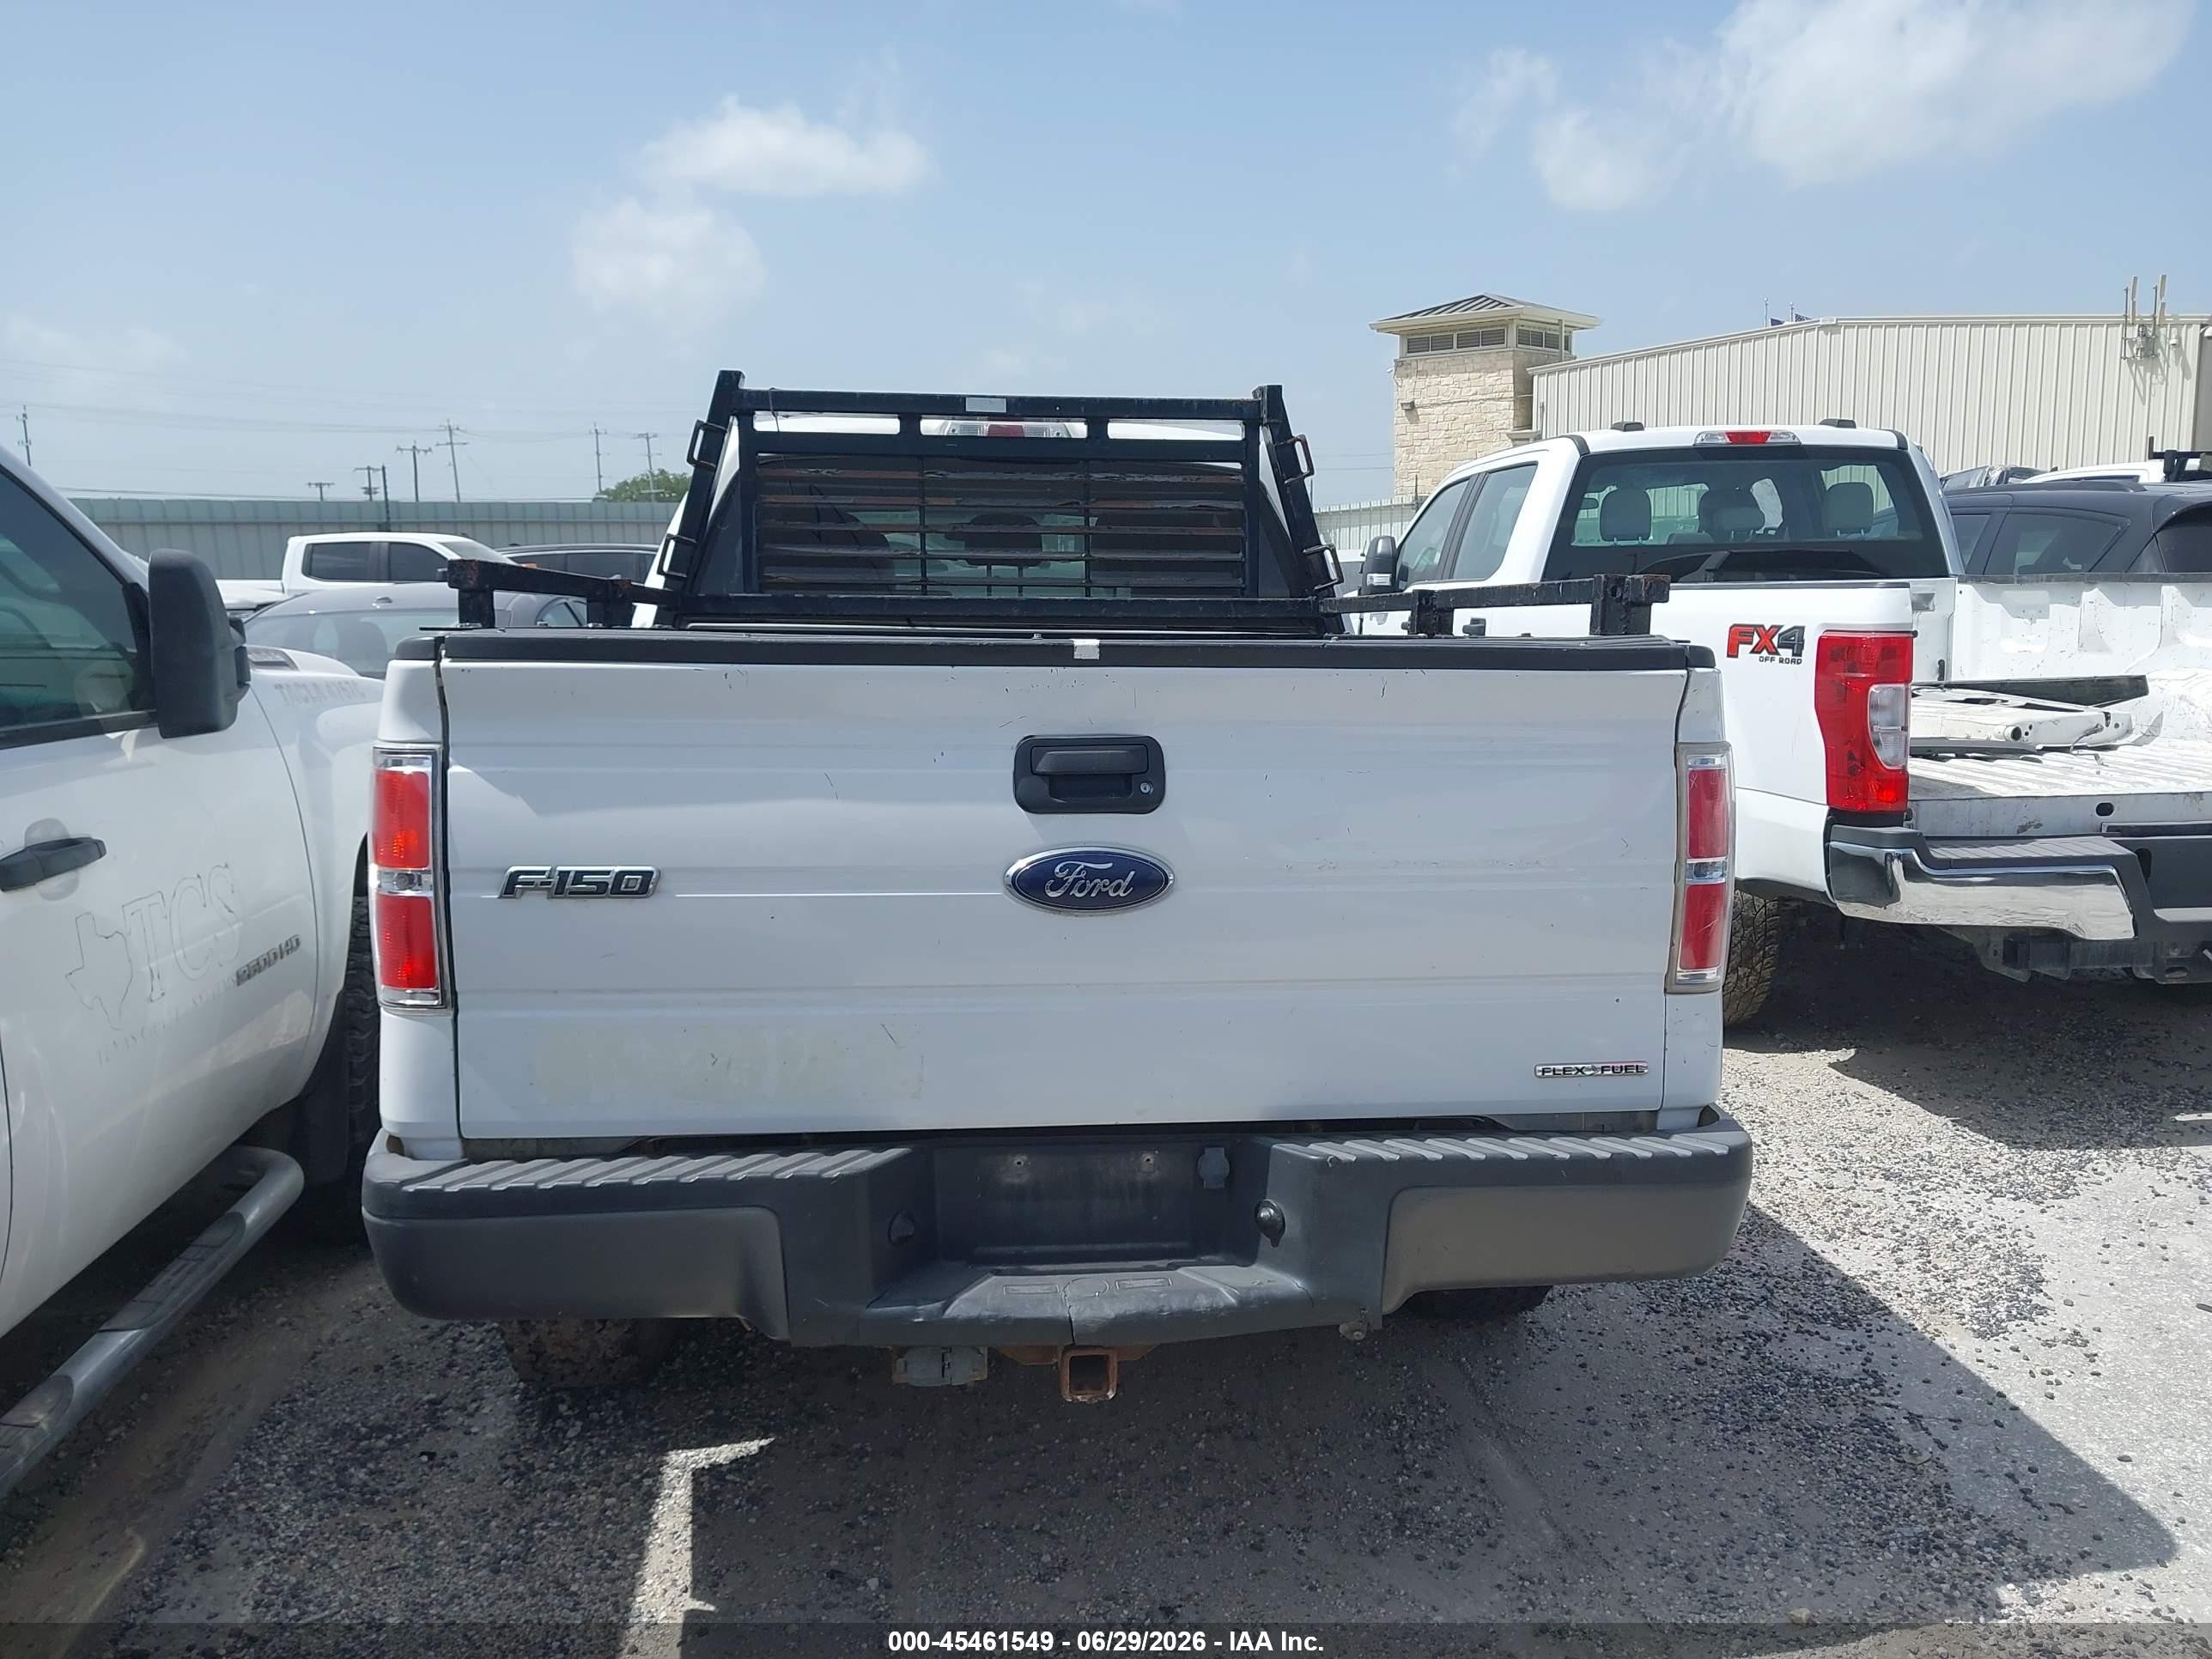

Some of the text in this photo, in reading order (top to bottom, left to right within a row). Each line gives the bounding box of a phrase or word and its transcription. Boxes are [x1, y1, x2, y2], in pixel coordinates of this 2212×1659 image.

[1726, 623, 1806, 659] FX4
[1759, 655, 1802, 665] OFF ROAD
[498, 866, 661, 899] F-150
[1044, 860, 1136, 898] Ford
[121, 862, 241, 1004] TCS
[1541, 1064, 1645, 1077] FLEX FUEL
